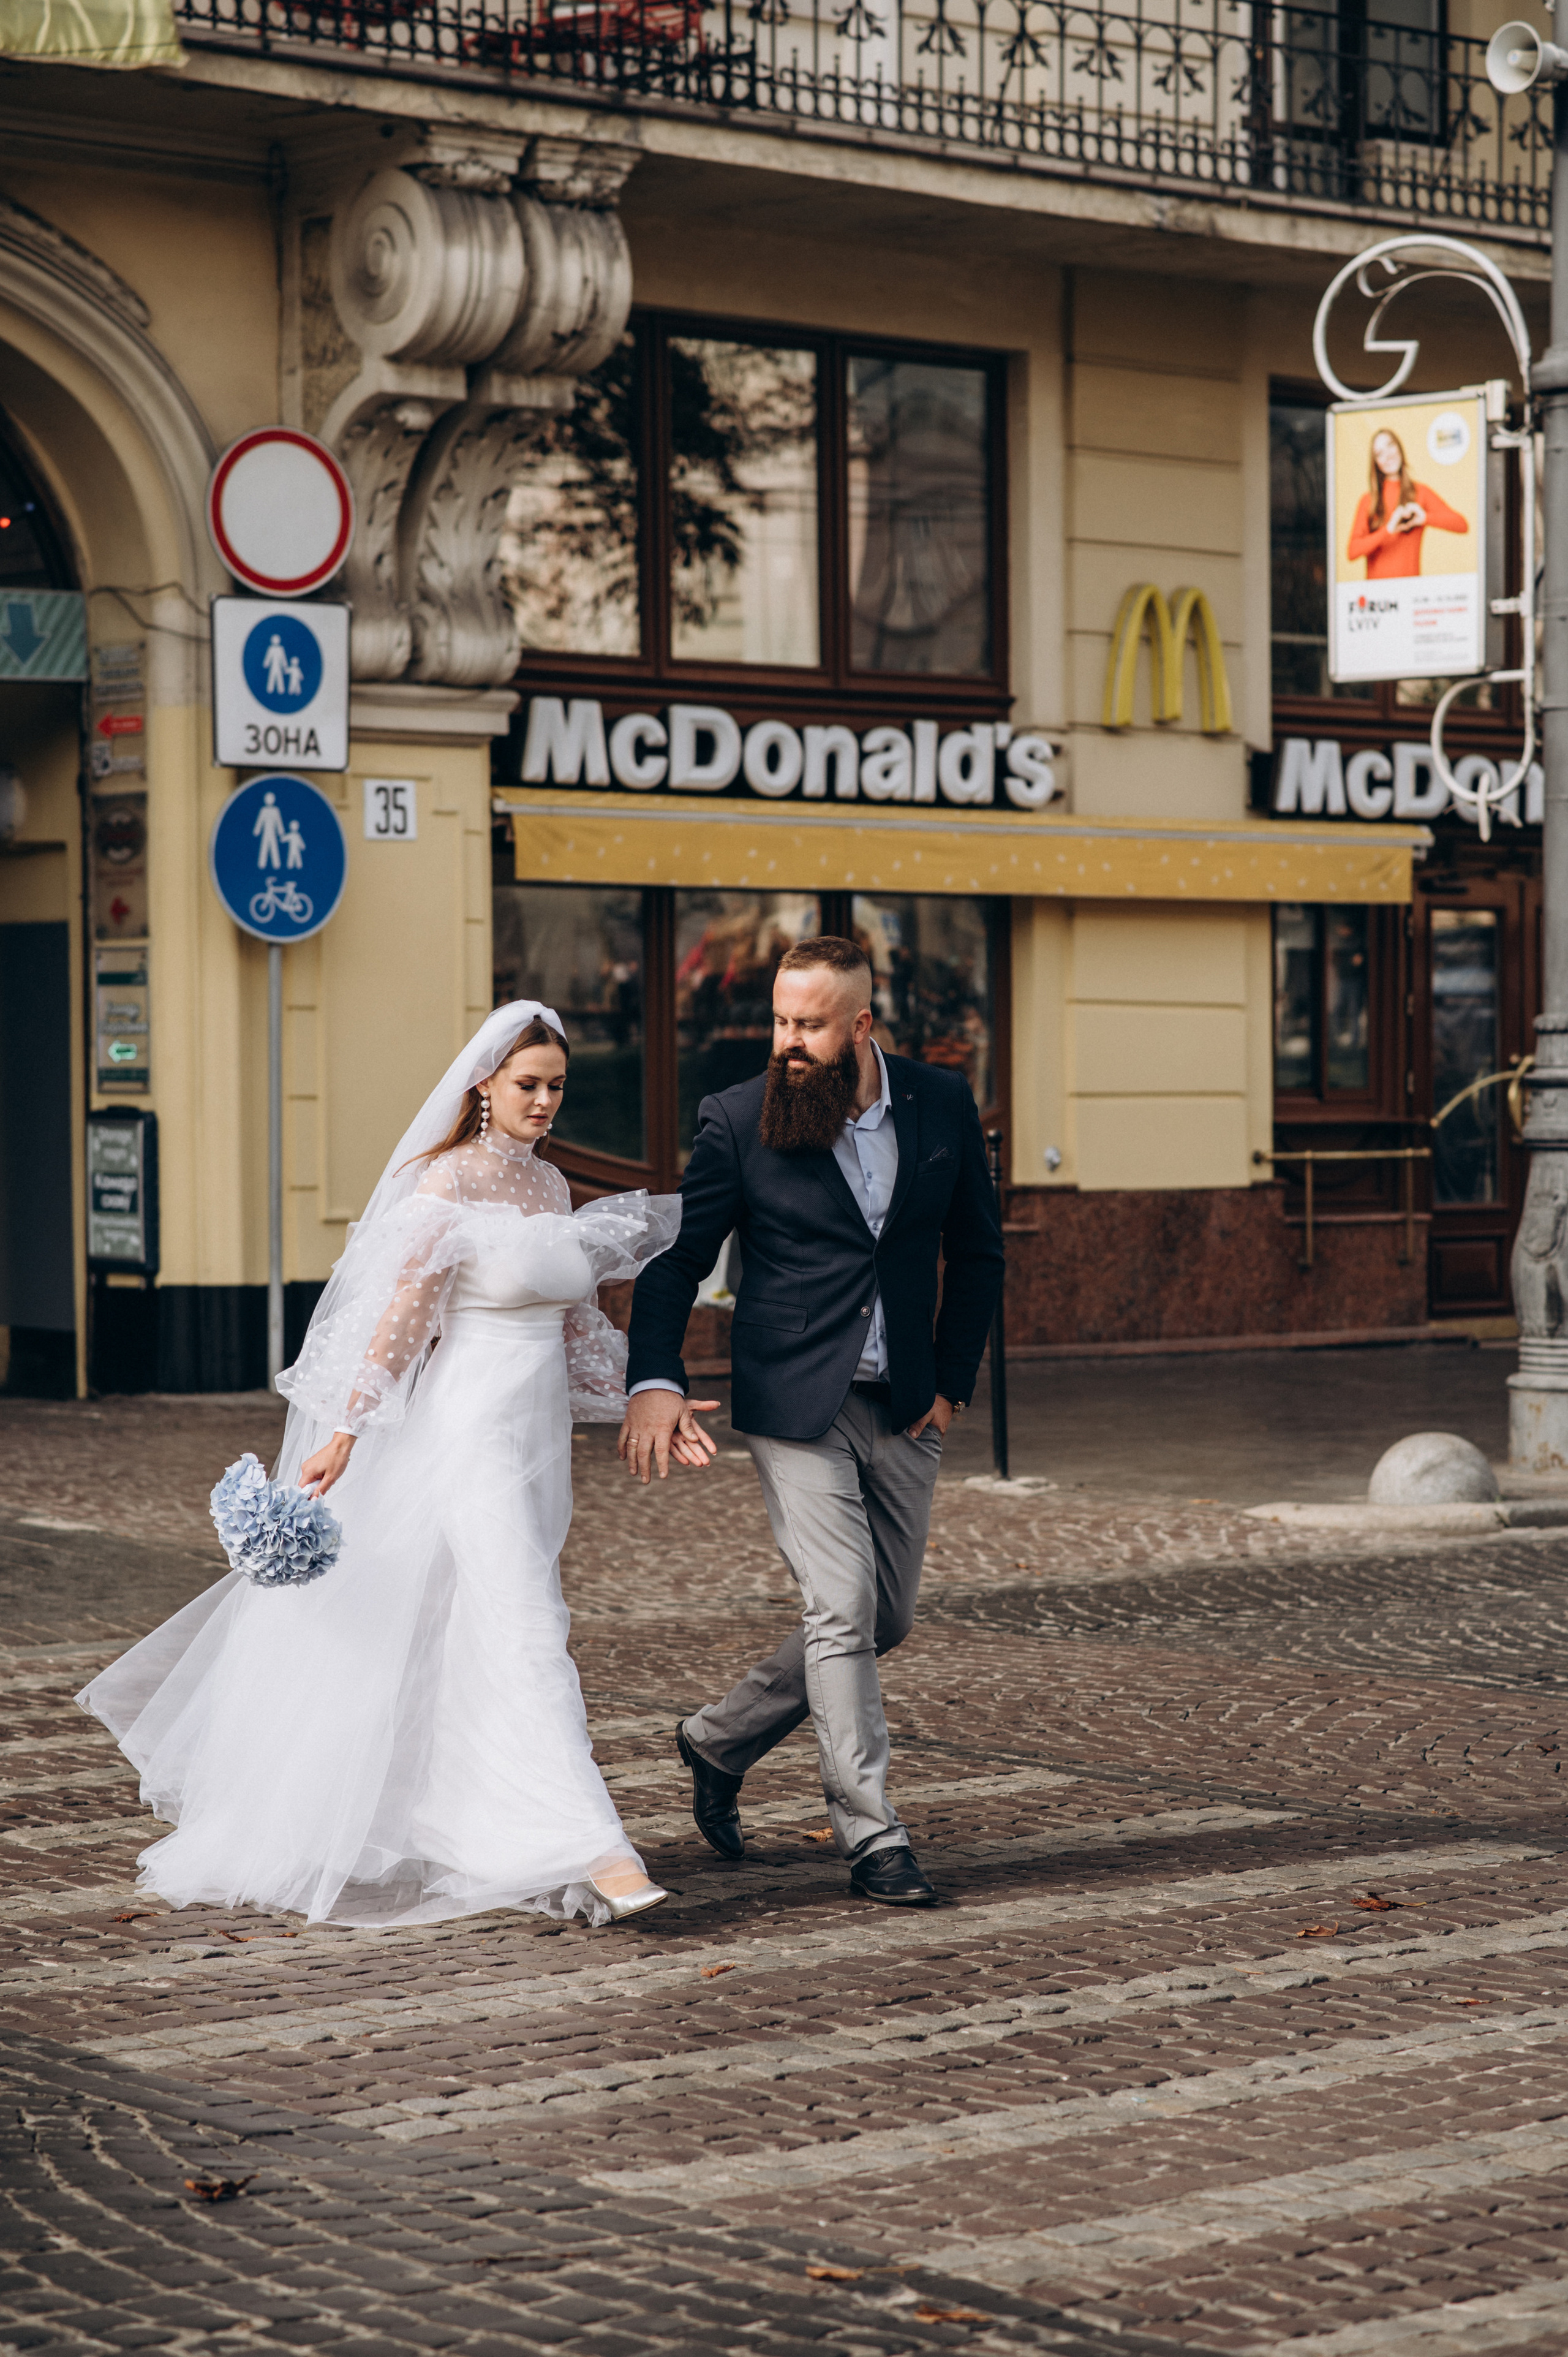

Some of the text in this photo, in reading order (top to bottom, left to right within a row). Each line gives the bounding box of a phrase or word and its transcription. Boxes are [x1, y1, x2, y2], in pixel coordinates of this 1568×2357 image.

[1349, 617, 1380, 632] LVIV
[245, 724, 321, 756] ЗОНА
[521, 696, 1055, 808] McDonald's
[375, 786, 407, 834] 35
